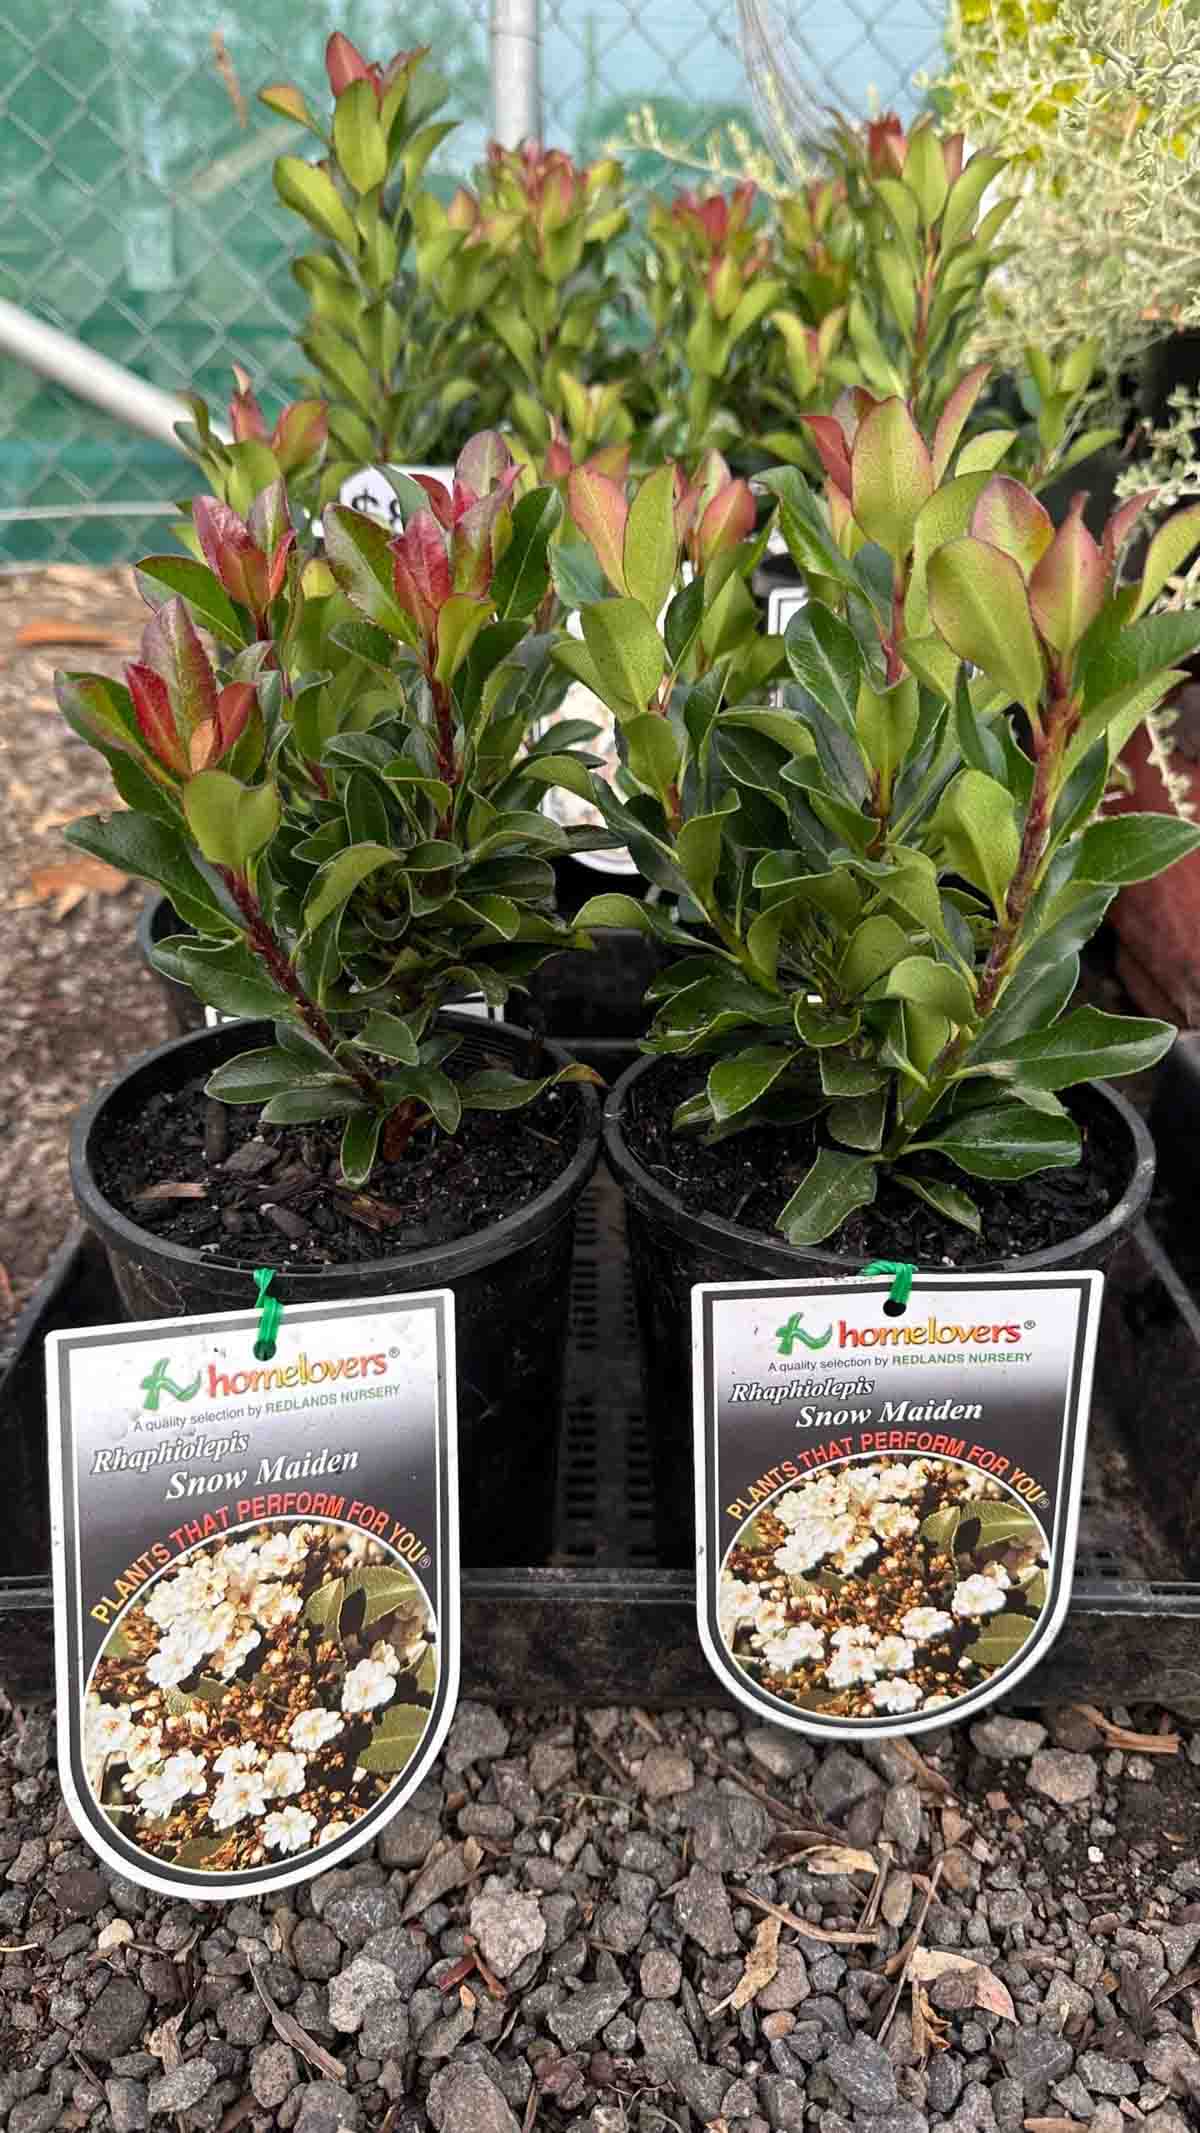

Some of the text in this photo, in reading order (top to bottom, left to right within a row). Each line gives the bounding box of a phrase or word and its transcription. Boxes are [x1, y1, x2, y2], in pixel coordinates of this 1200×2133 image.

[768, 1352, 1032, 1373] A quality selection by REDLANDS NURSERY
[133, 1384, 400, 1434] A quality selection by REDLANDS NURSERY
[729, 1376, 875, 1406] Rhaphiolepis
[795, 1399, 983, 1428] Snow Maiden
[90, 1431, 250, 1476] Rhaphiolepis
[165, 1449, 359, 1500] Snow Maiden
[725, 1461, 799, 1520] PLANTS
[798, 1437, 853, 1468] THAT
[861, 1431, 965, 1456] PERFORM
[966, 1446, 1010, 1474] FOR
[90, 1542, 172, 1624] PLANTS
[169, 1505, 230, 1550] THAT
[237, 1491, 344, 1521] PERFORM
[346, 1497, 391, 1531] FOR
